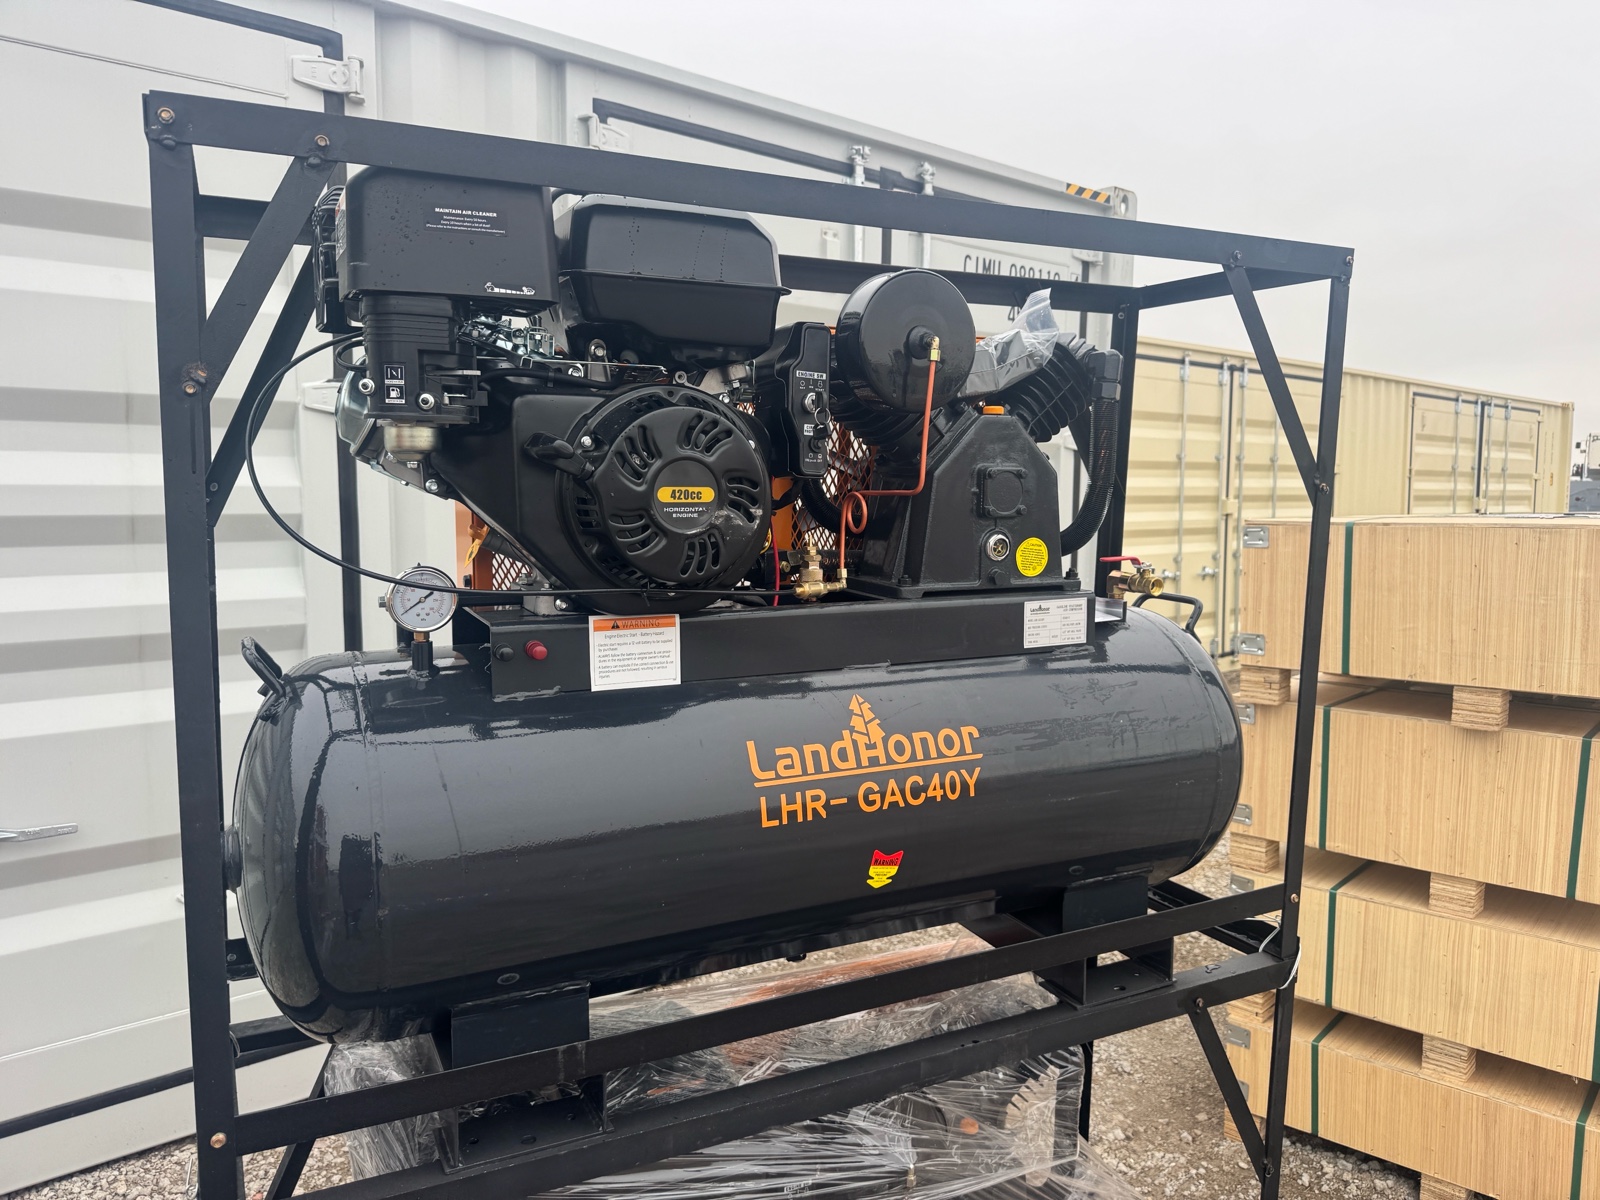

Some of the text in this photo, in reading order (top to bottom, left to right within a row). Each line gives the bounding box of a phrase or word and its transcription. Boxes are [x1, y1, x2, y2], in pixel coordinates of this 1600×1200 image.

[670, 489, 702, 500] 420cc
[622, 619, 660, 628] WARNING
[746, 726, 980, 780] LandHonor
[857, 767, 981, 813] GAC40Y
